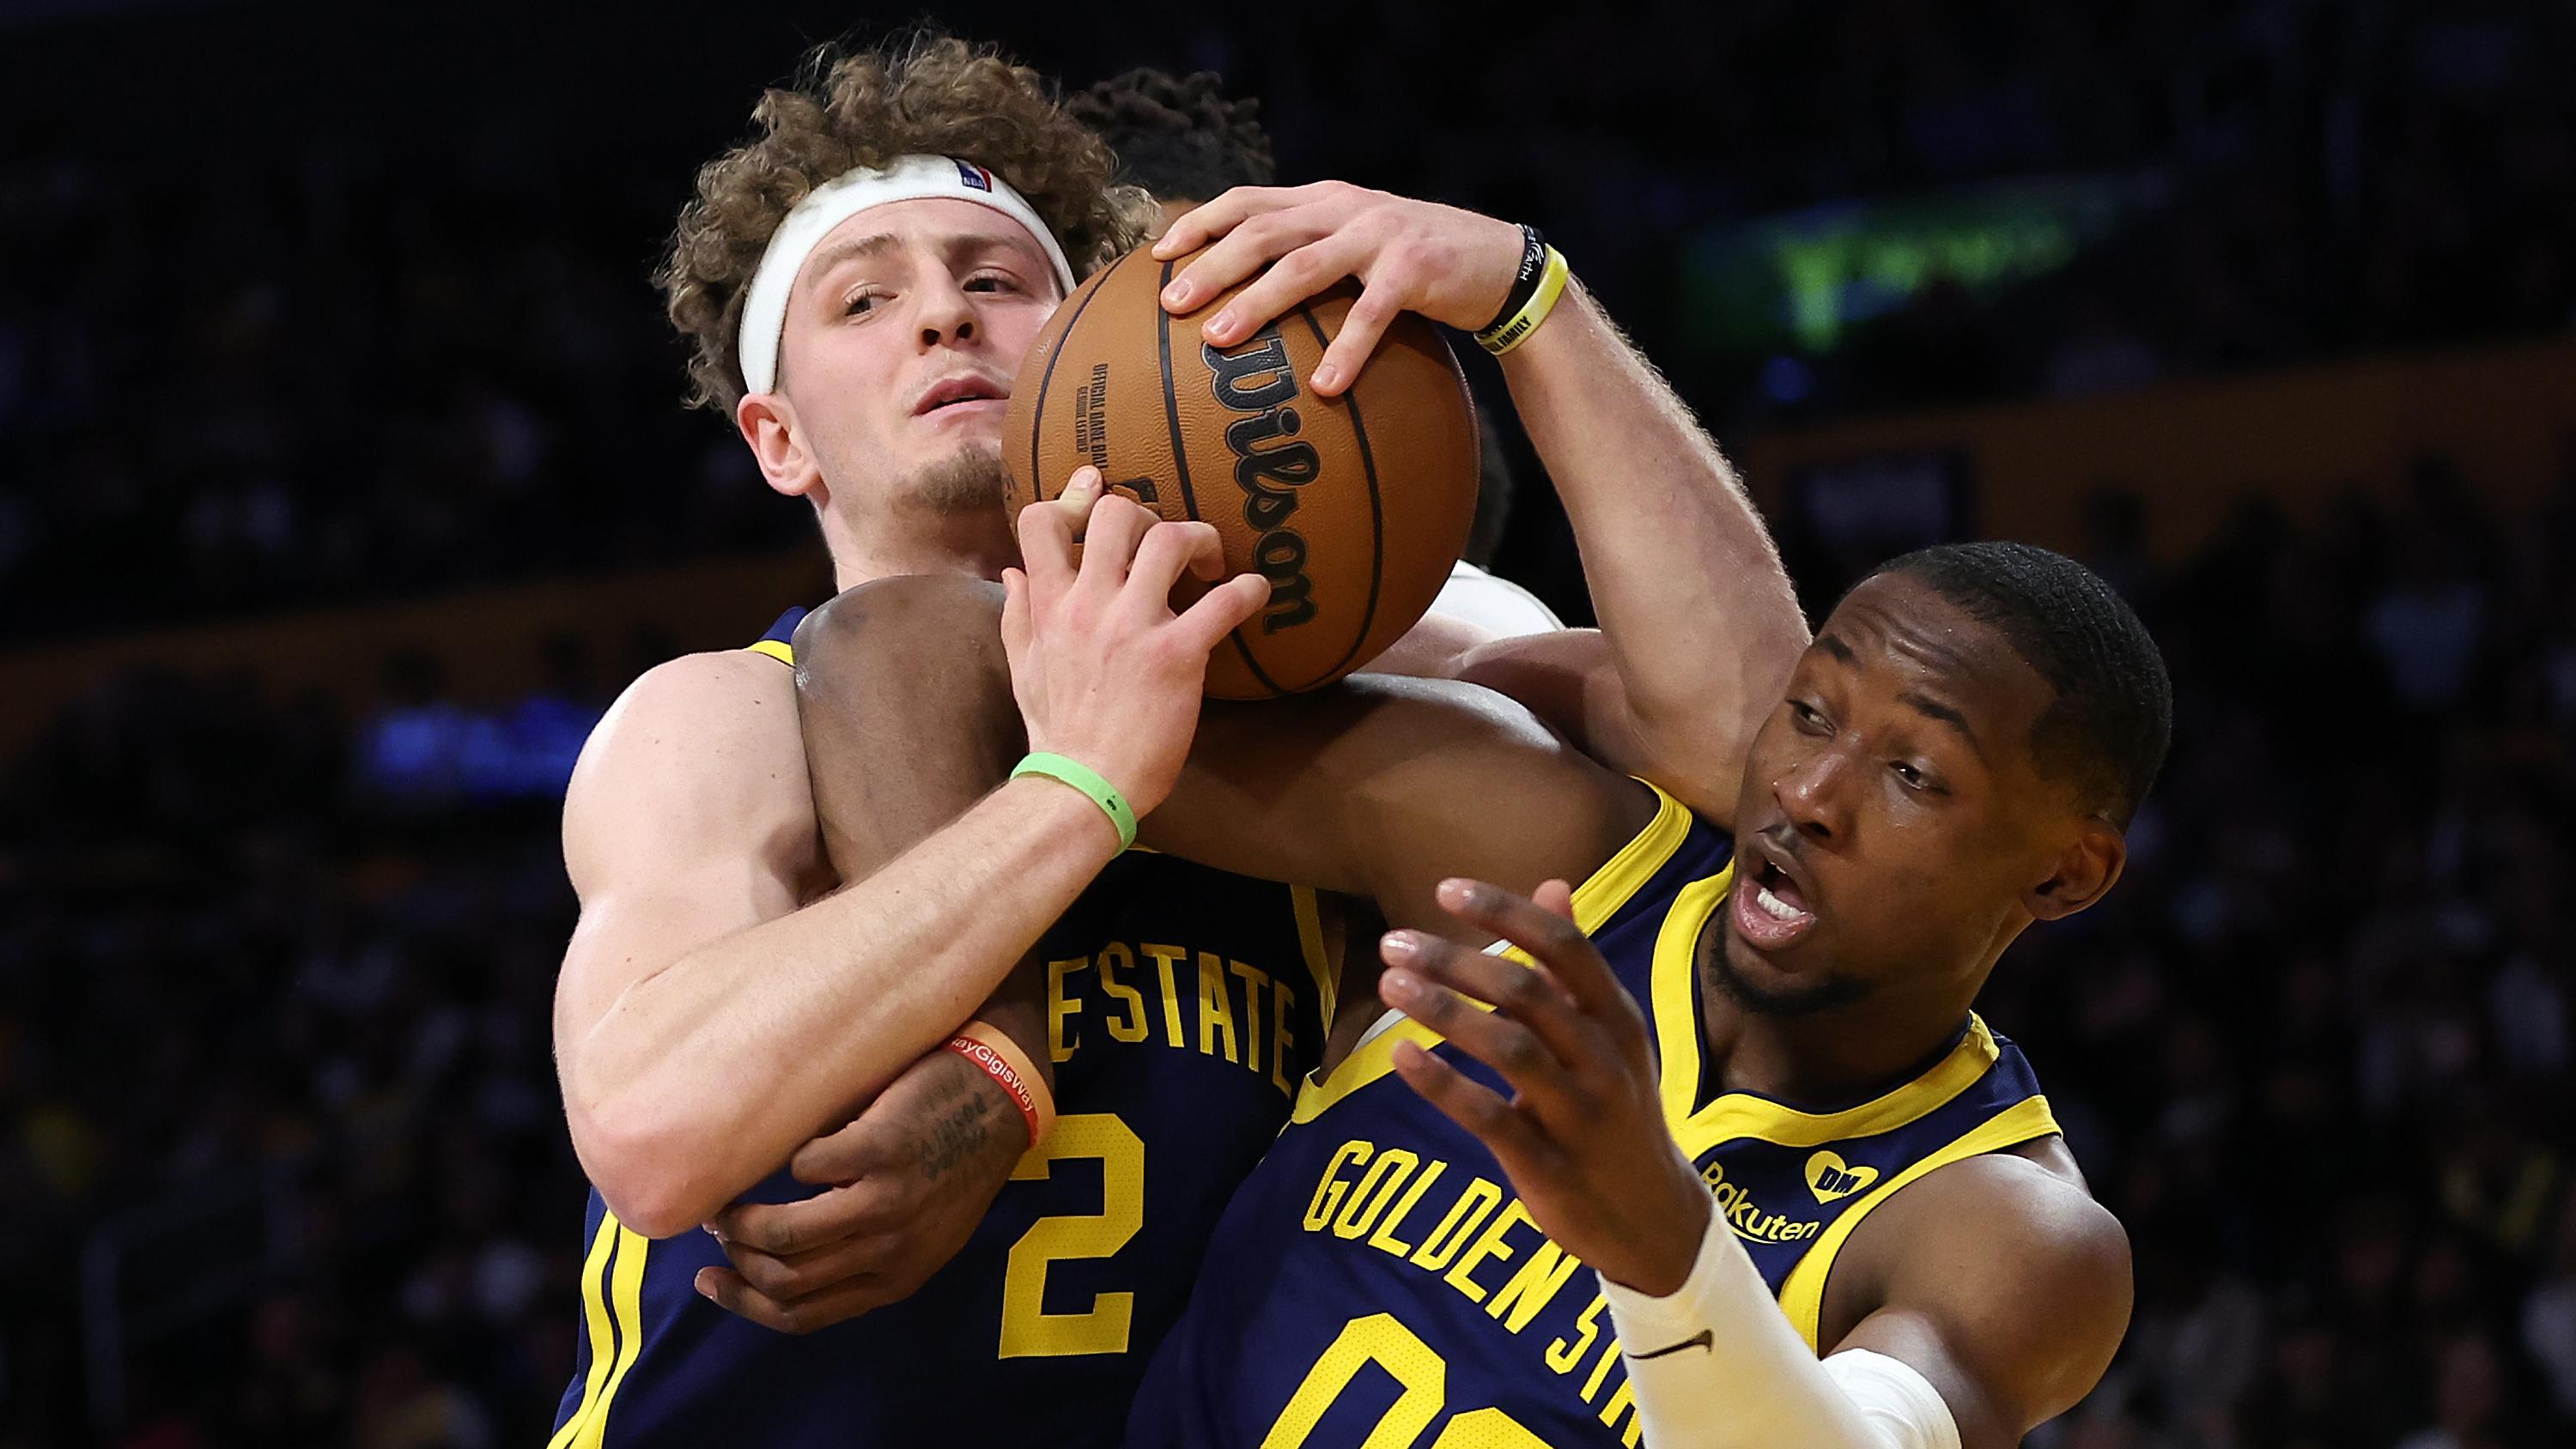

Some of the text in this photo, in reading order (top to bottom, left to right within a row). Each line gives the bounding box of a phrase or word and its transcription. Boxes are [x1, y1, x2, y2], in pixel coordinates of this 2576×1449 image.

[963, 176, 984, 188] NBA
[1089, 363, 1109, 410] OFFICIAL
[1201, 324, 1321, 635] Wilson
[1699, 1161, 1820, 1243] Rakuten
[1814, 1164, 1862, 1194] DM
[999, 1113, 1145, 1360] 2
[1303, 1139, 1582, 1335] GOLDEN
